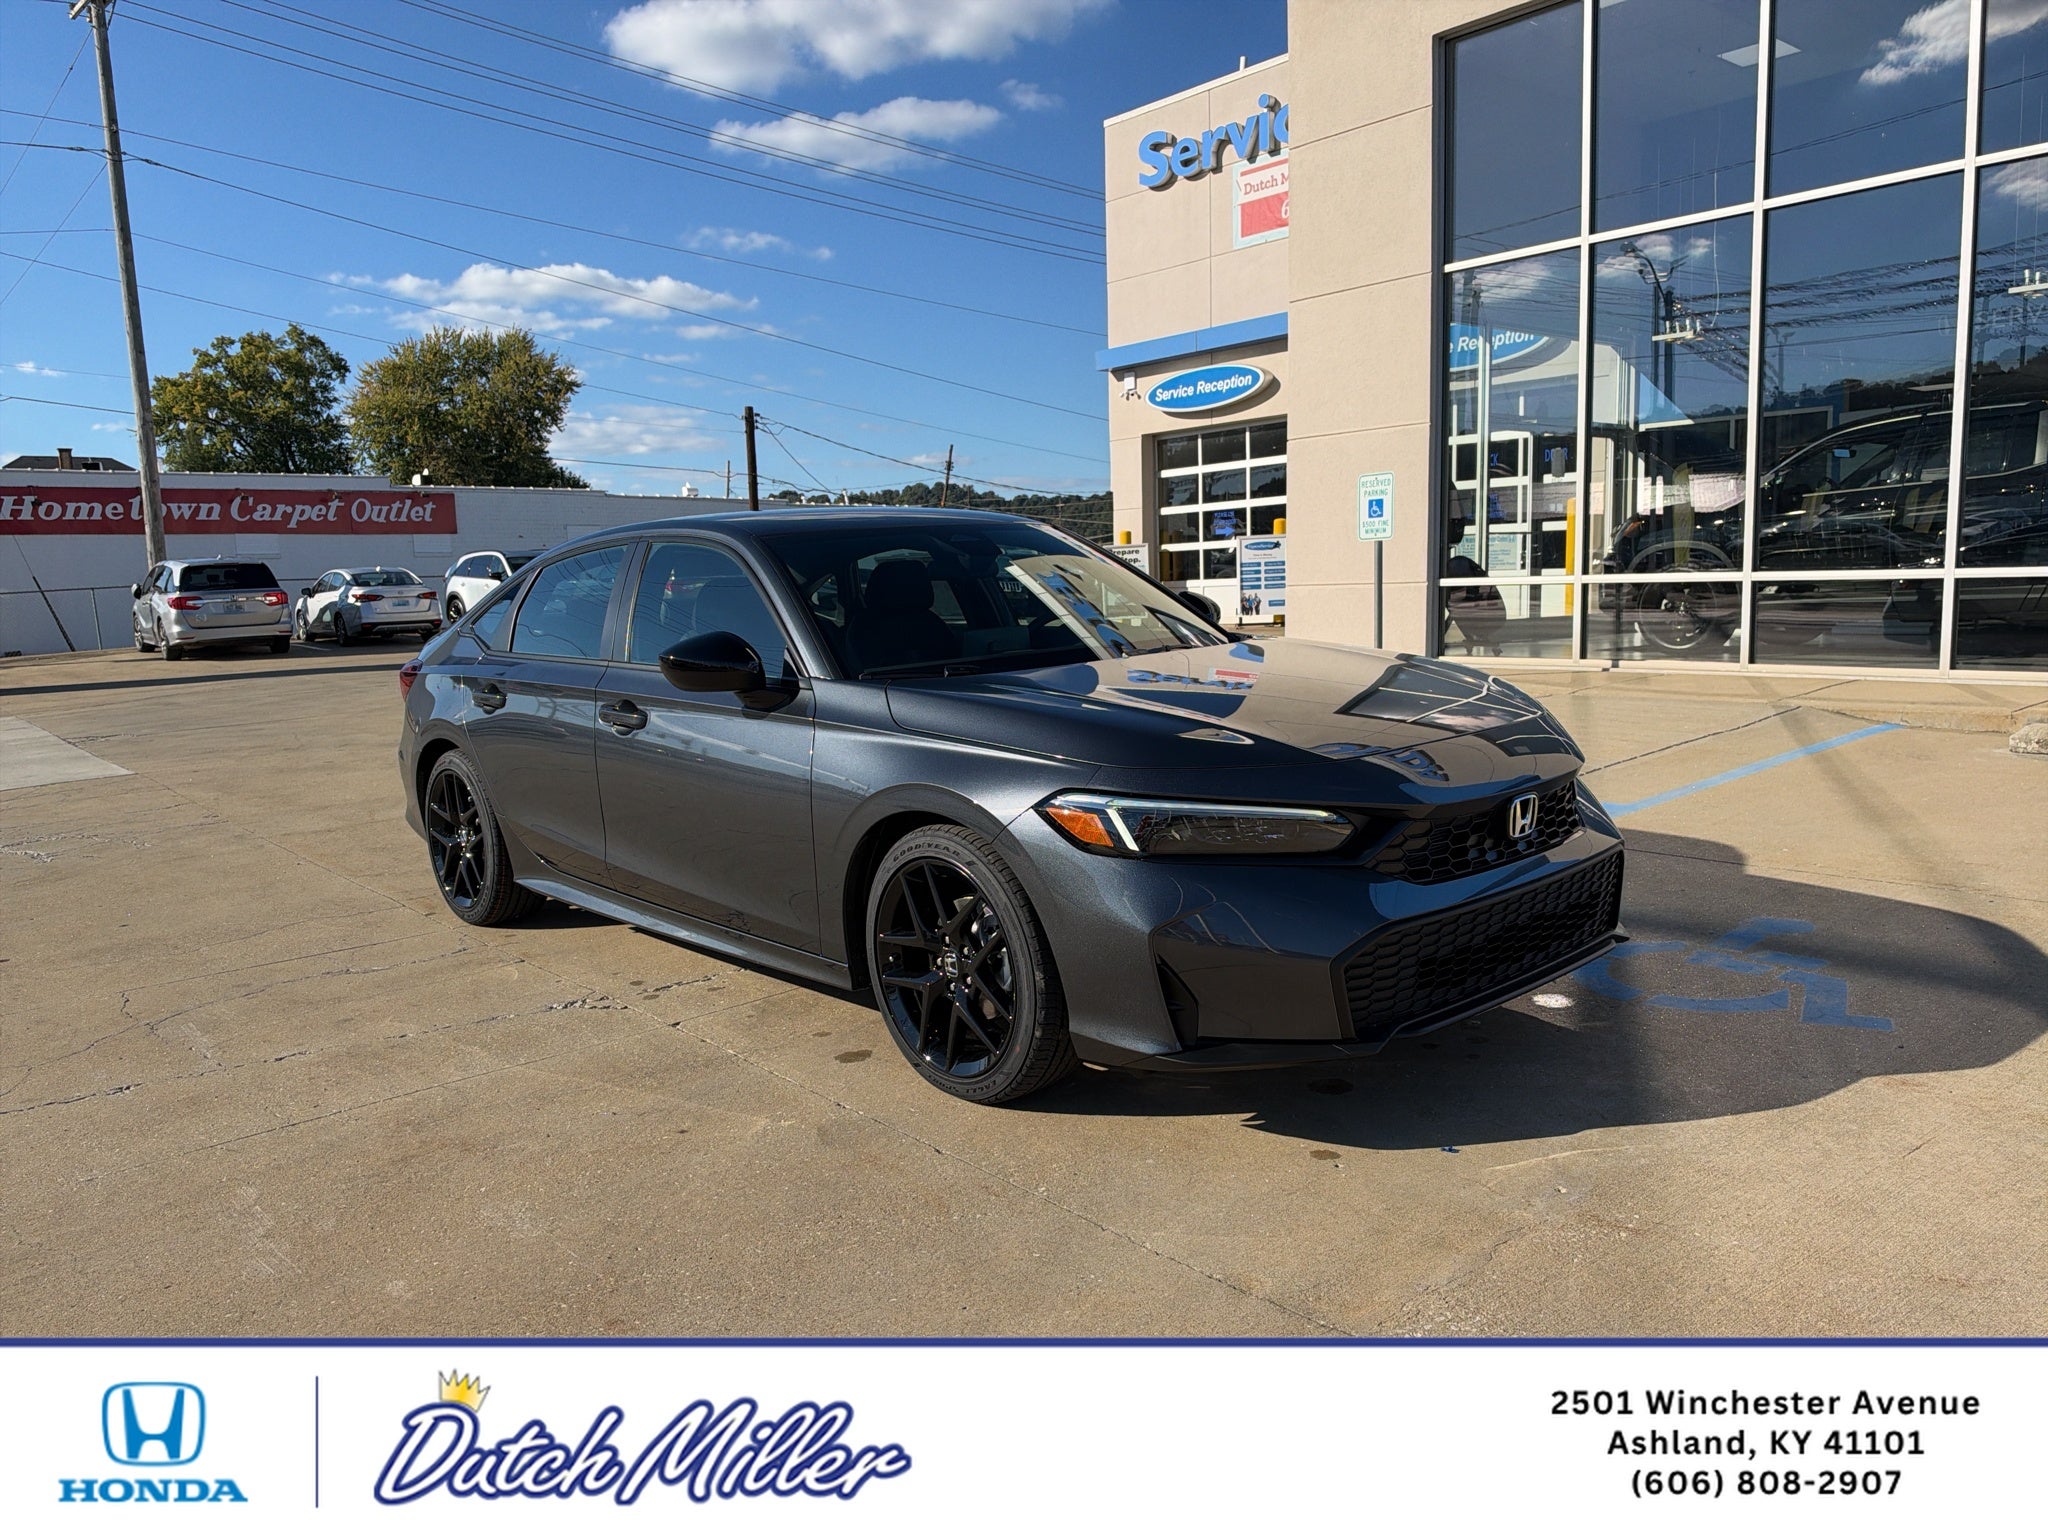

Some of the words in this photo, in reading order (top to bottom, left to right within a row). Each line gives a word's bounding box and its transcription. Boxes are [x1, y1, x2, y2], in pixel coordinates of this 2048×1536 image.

[1243, 174, 1279, 195] Dutch
[1155, 385, 1194, 402] Service
[1196, 374, 1252, 394] Reception
[1361, 479, 1391, 488] RESERVED
[1364, 488, 1388, 497] PARKING
[230, 496, 344, 528] Carpet
[351, 498, 436, 523] Outlet
[893, 842, 961, 862] GOODYEAR
